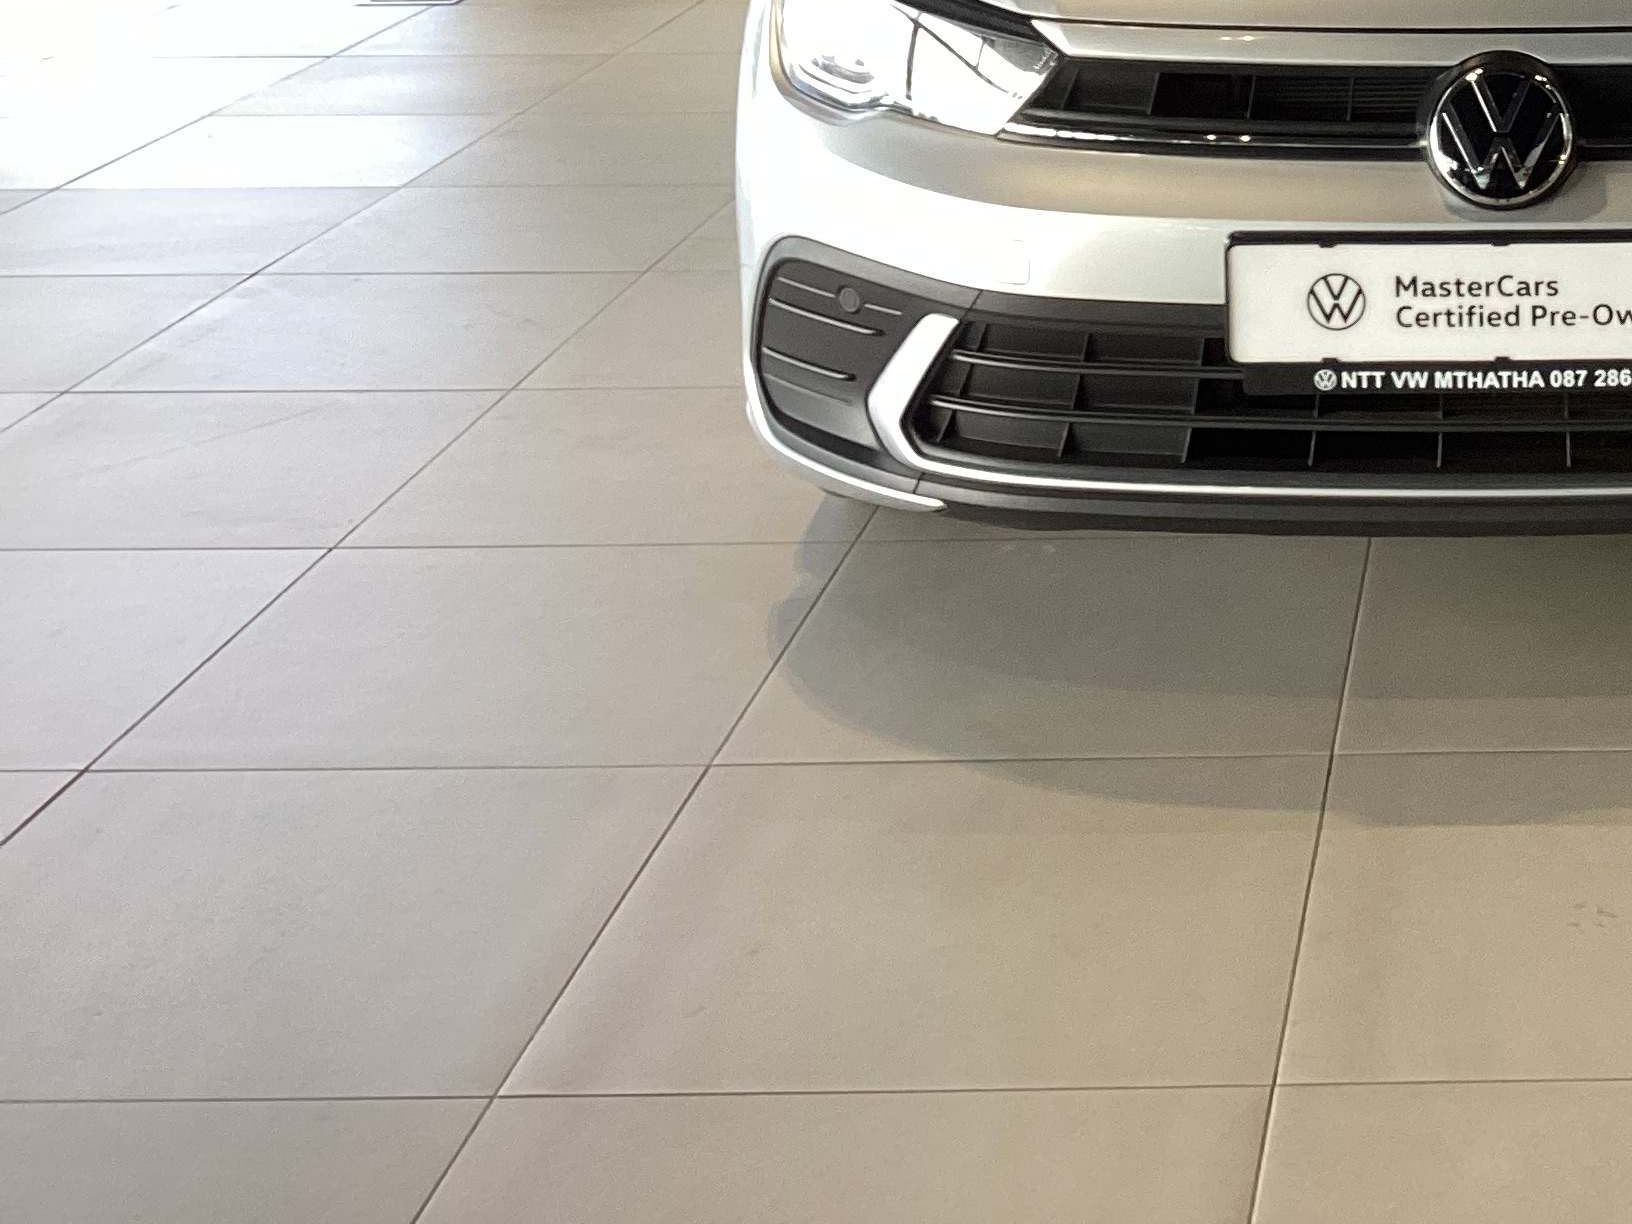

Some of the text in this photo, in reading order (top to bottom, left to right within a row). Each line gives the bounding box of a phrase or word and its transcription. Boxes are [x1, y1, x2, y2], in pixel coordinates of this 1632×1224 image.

[1395, 274, 1559, 298] MasterCars
[1396, 304, 1520, 328] Certified
[1341, 370, 1386, 389] NTT
[1390, 370, 1429, 389] VW
[1433, 369, 1545, 389] MTHATHA
[1549, 369, 1588, 388] 087
[1593, 368, 1632, 387] 286
